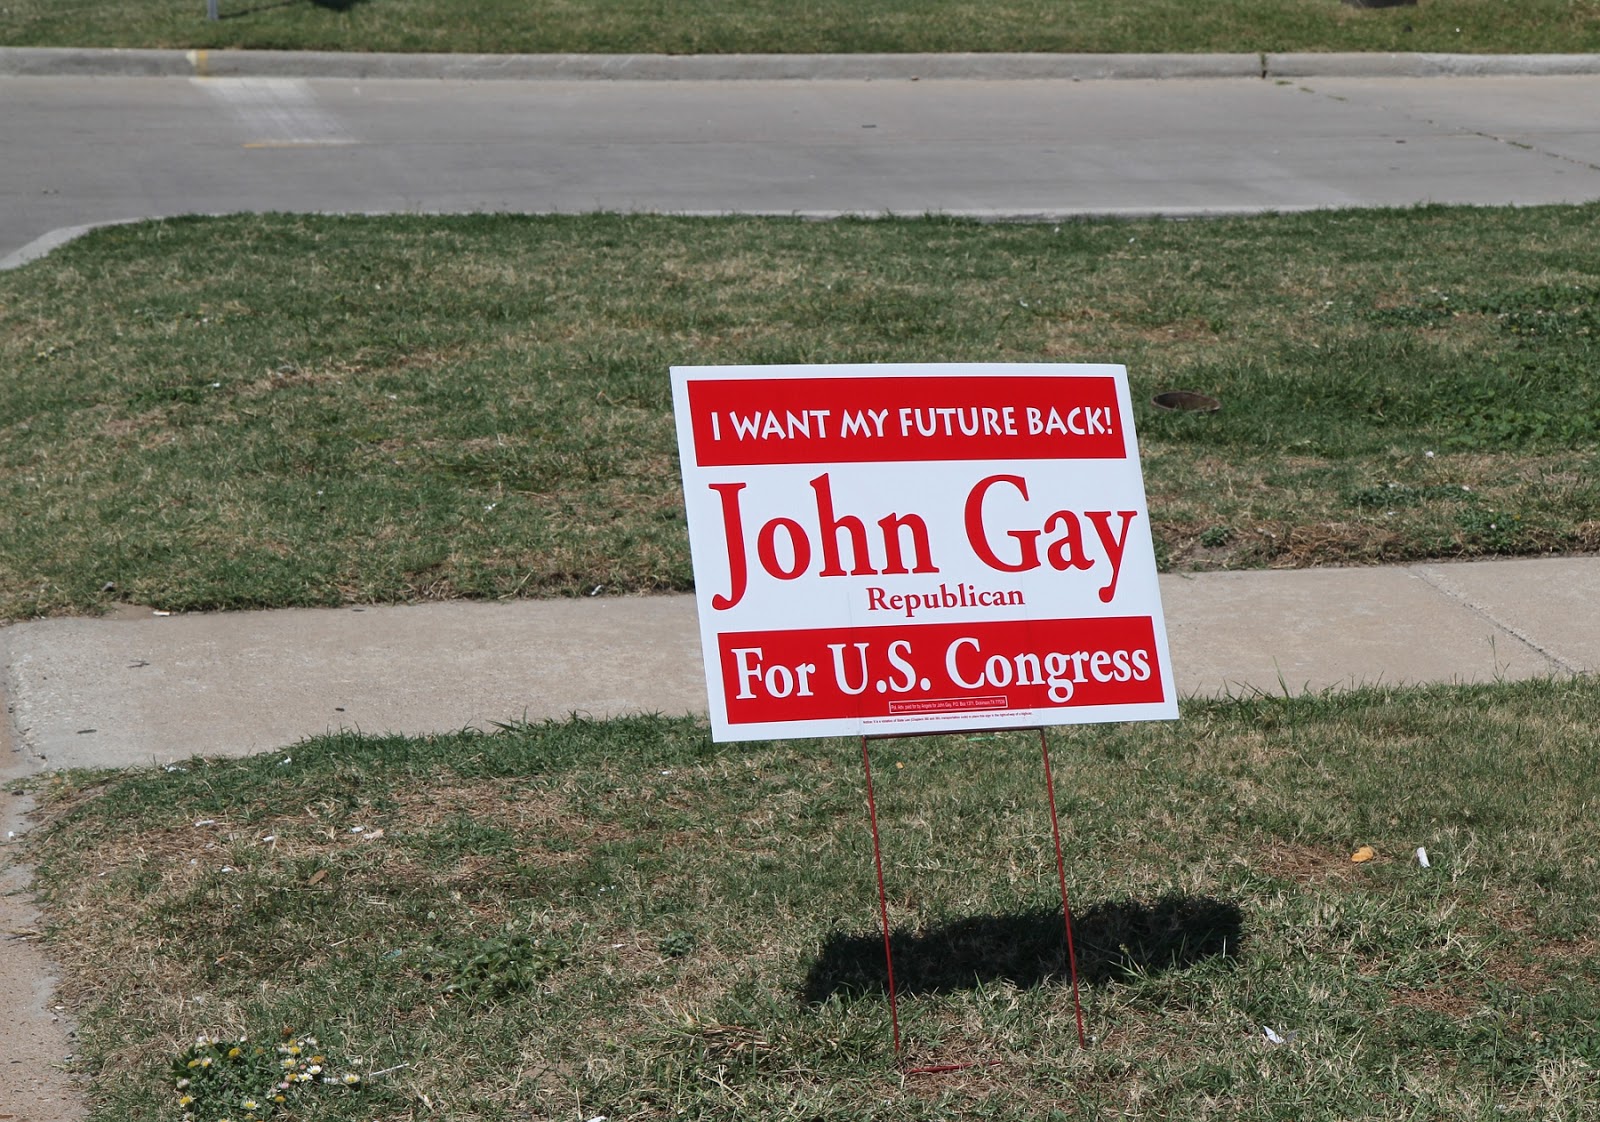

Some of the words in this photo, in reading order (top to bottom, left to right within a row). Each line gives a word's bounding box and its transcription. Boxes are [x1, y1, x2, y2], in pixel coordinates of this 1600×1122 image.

[711, 411, 721, 441] I
[729, 409, 831, 441] WANT
[840, 408, 889, 439] MY
[898, 407, 1018, 437] FUTURE
[1026, 406, 1114, 436] BACK!
[708, 472, 940, 611] John
[963, 473, 1138, 604] Gay
[866, 583, 1026, 618] Republican
[730, 646, 816, 700] For
[827, 640, 932, 695] U.S.
[945, 637, 1151, 703] Congress
